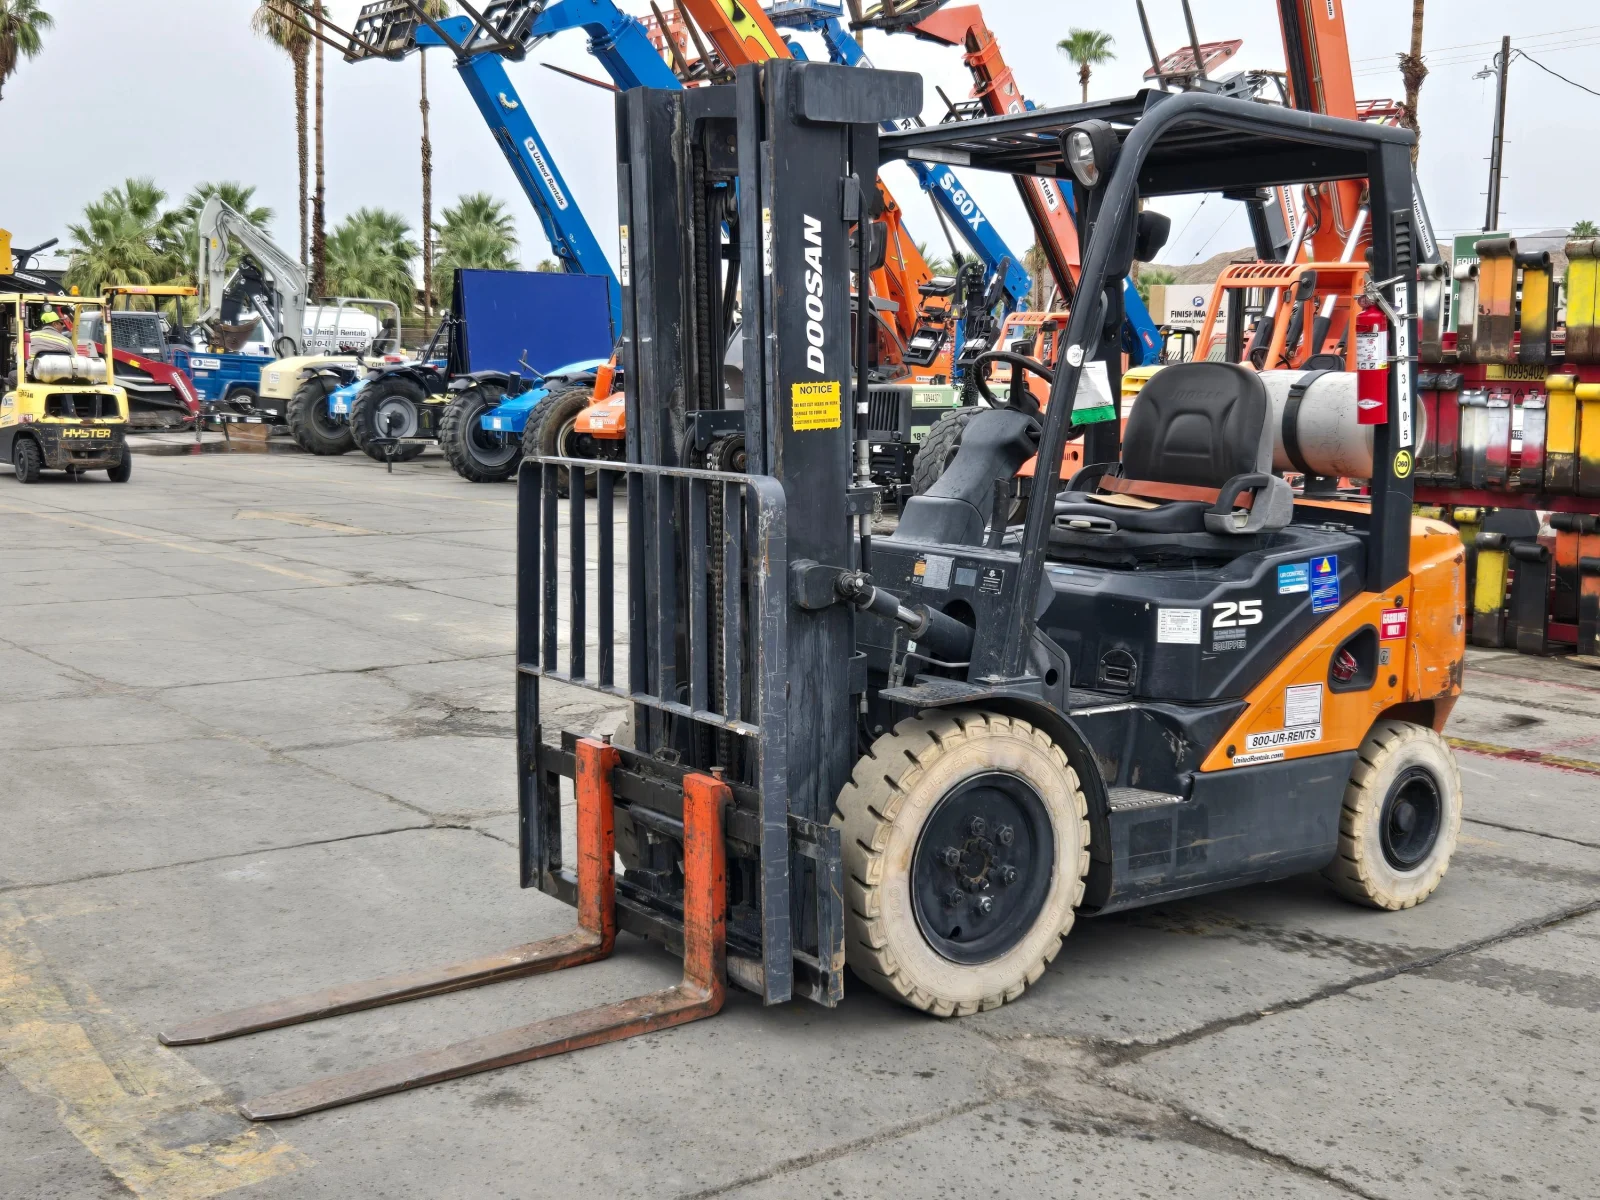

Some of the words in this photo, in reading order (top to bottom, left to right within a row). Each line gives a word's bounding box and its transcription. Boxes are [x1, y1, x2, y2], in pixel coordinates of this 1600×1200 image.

[532, 151, 550, 179] United
[546, 177, 565, 206] Rentals
[1040, 178, 1055, 205] ntals
[939, 172, 986, 231] S-60X
[803, 213, 825, 374] DOOSAN
[340, 329, 366, 337] Rentals
[800, 384, 832, 395] NOTICE
[62, 428, 111, 438] HYSTER
[1212, 600, 1263, 628] 25
[1383, 611, 1406, 624] GASOLINE
[1387, 625, 1400, 635] ONLY
[1212, 640, 1246, 652] EQUIPPED
[1252, 729, 1317, 747] 800-UR-RENTS
[1233, 752, 1284, 764] UnitedRentals.com
